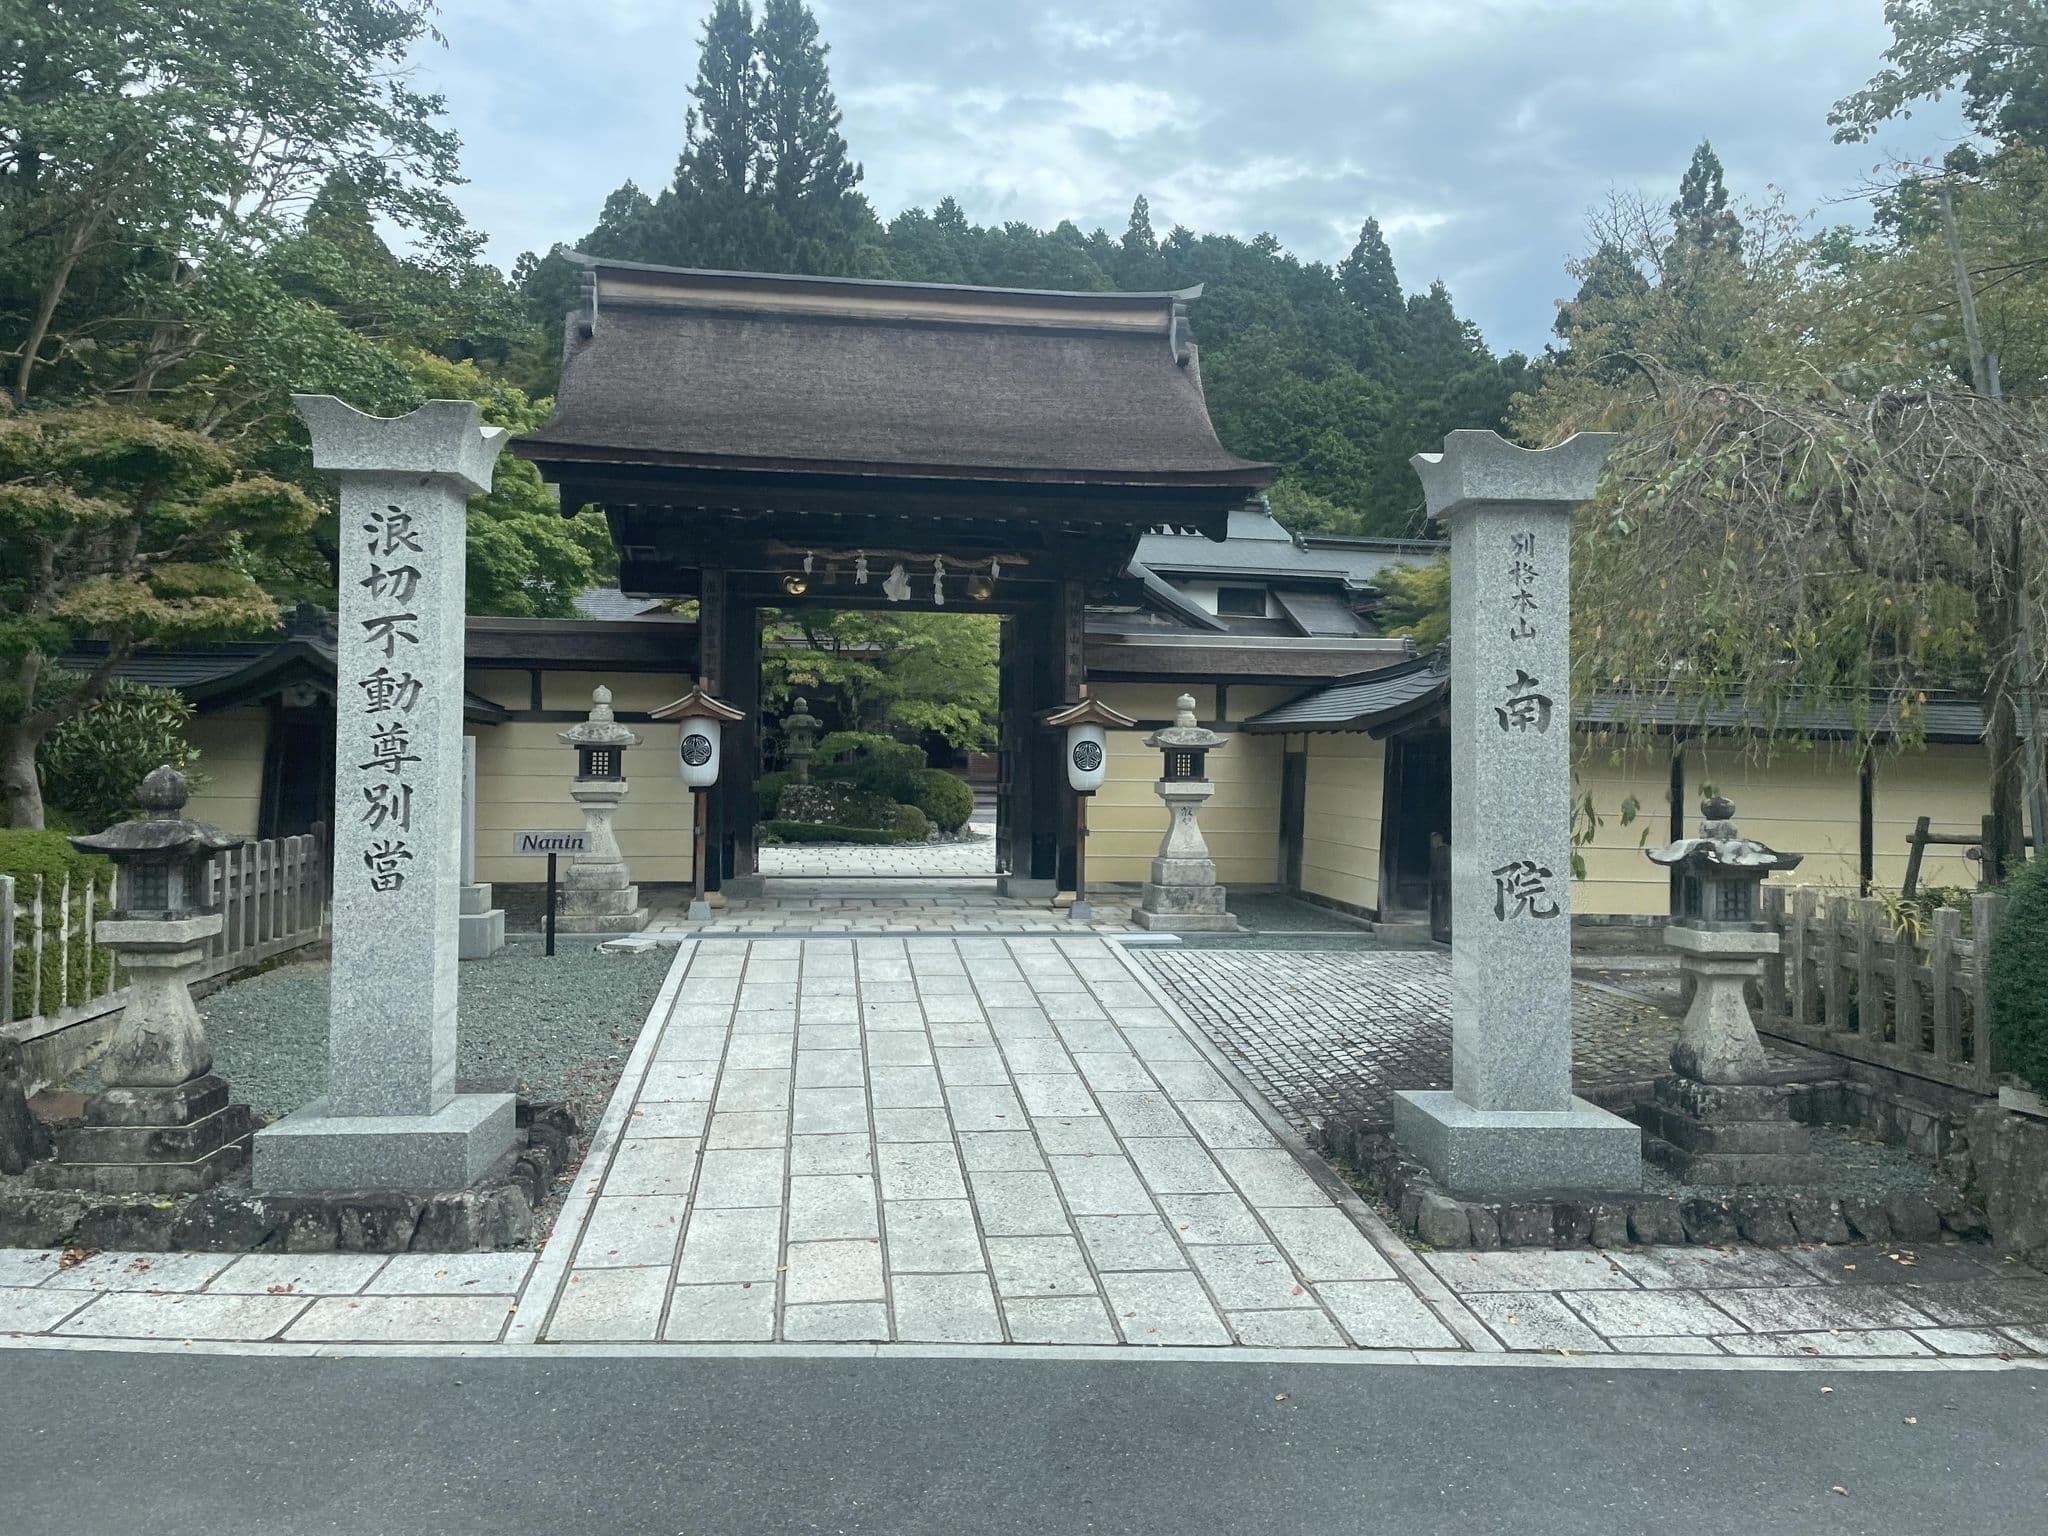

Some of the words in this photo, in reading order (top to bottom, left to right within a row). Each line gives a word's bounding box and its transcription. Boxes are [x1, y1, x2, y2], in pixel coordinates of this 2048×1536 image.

[358, 505, 423, 893] 浪切不動尊別當
[1491, 669, 1560, 922] 南院
[522, 835, 584, 850] Nanin
